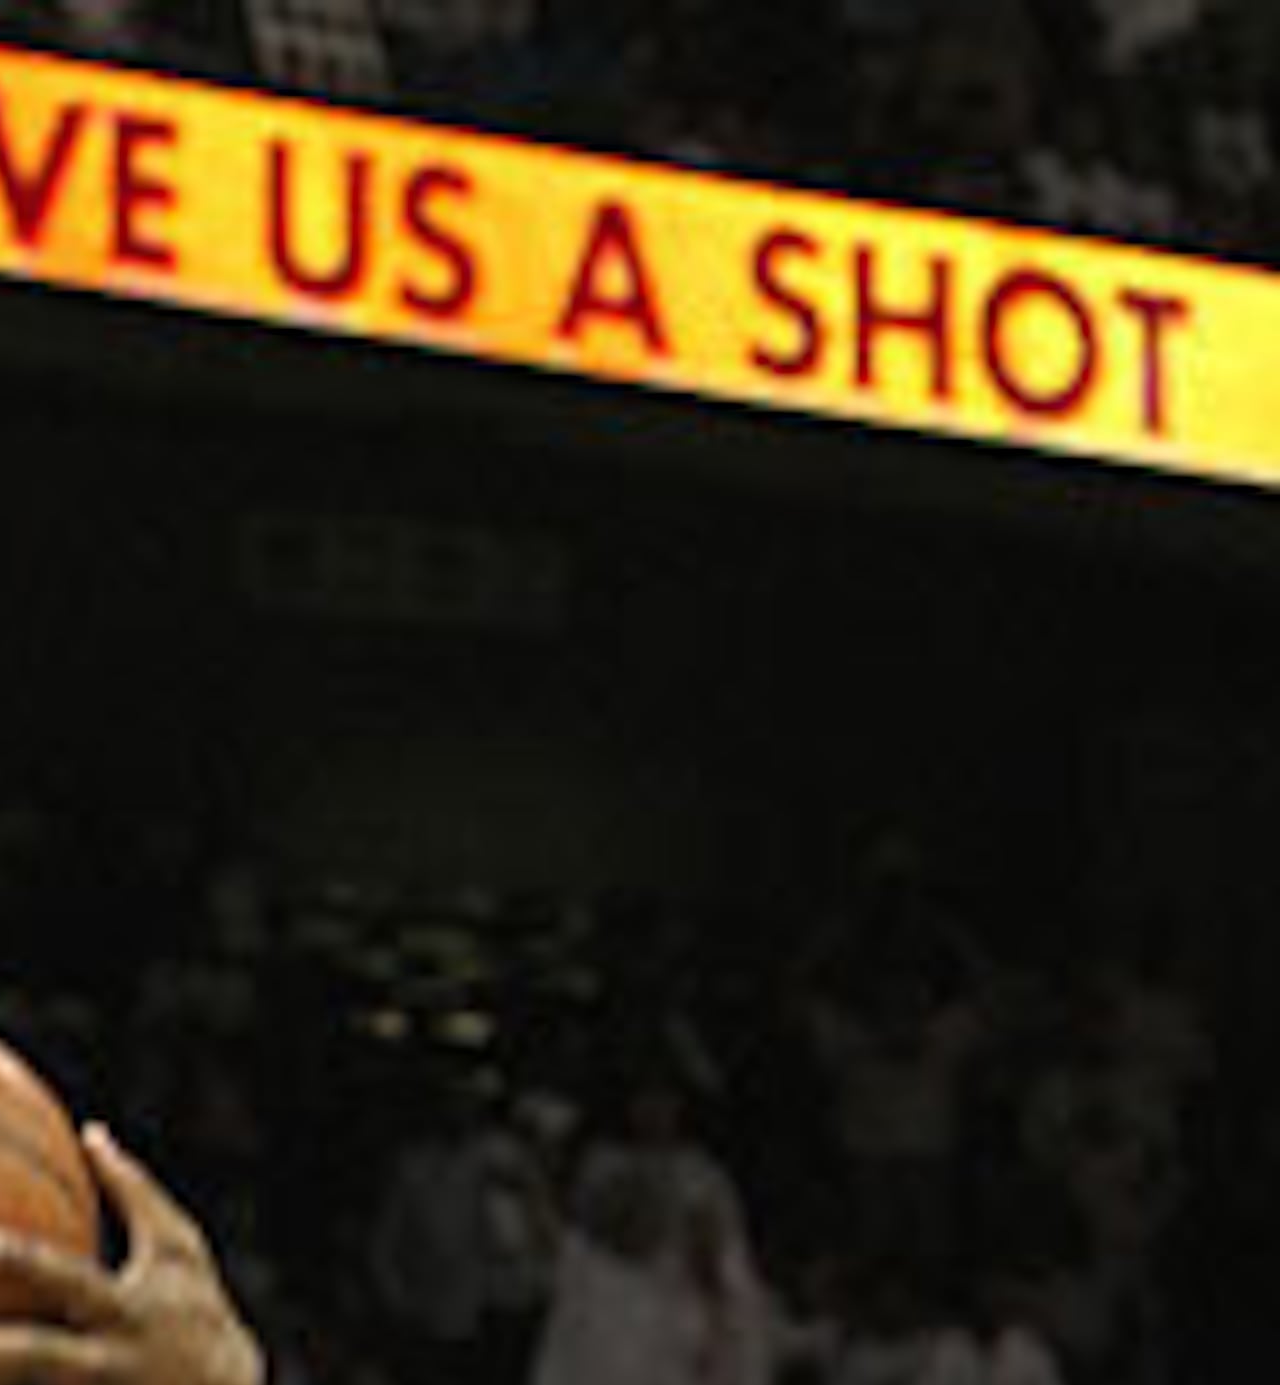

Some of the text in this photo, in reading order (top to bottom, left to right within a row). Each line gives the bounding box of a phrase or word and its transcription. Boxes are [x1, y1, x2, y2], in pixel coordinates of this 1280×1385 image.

[267, 138, 477, 320] US
[553, 200, 670, 357] A
[748, 225, 1189, 437] SHOT
